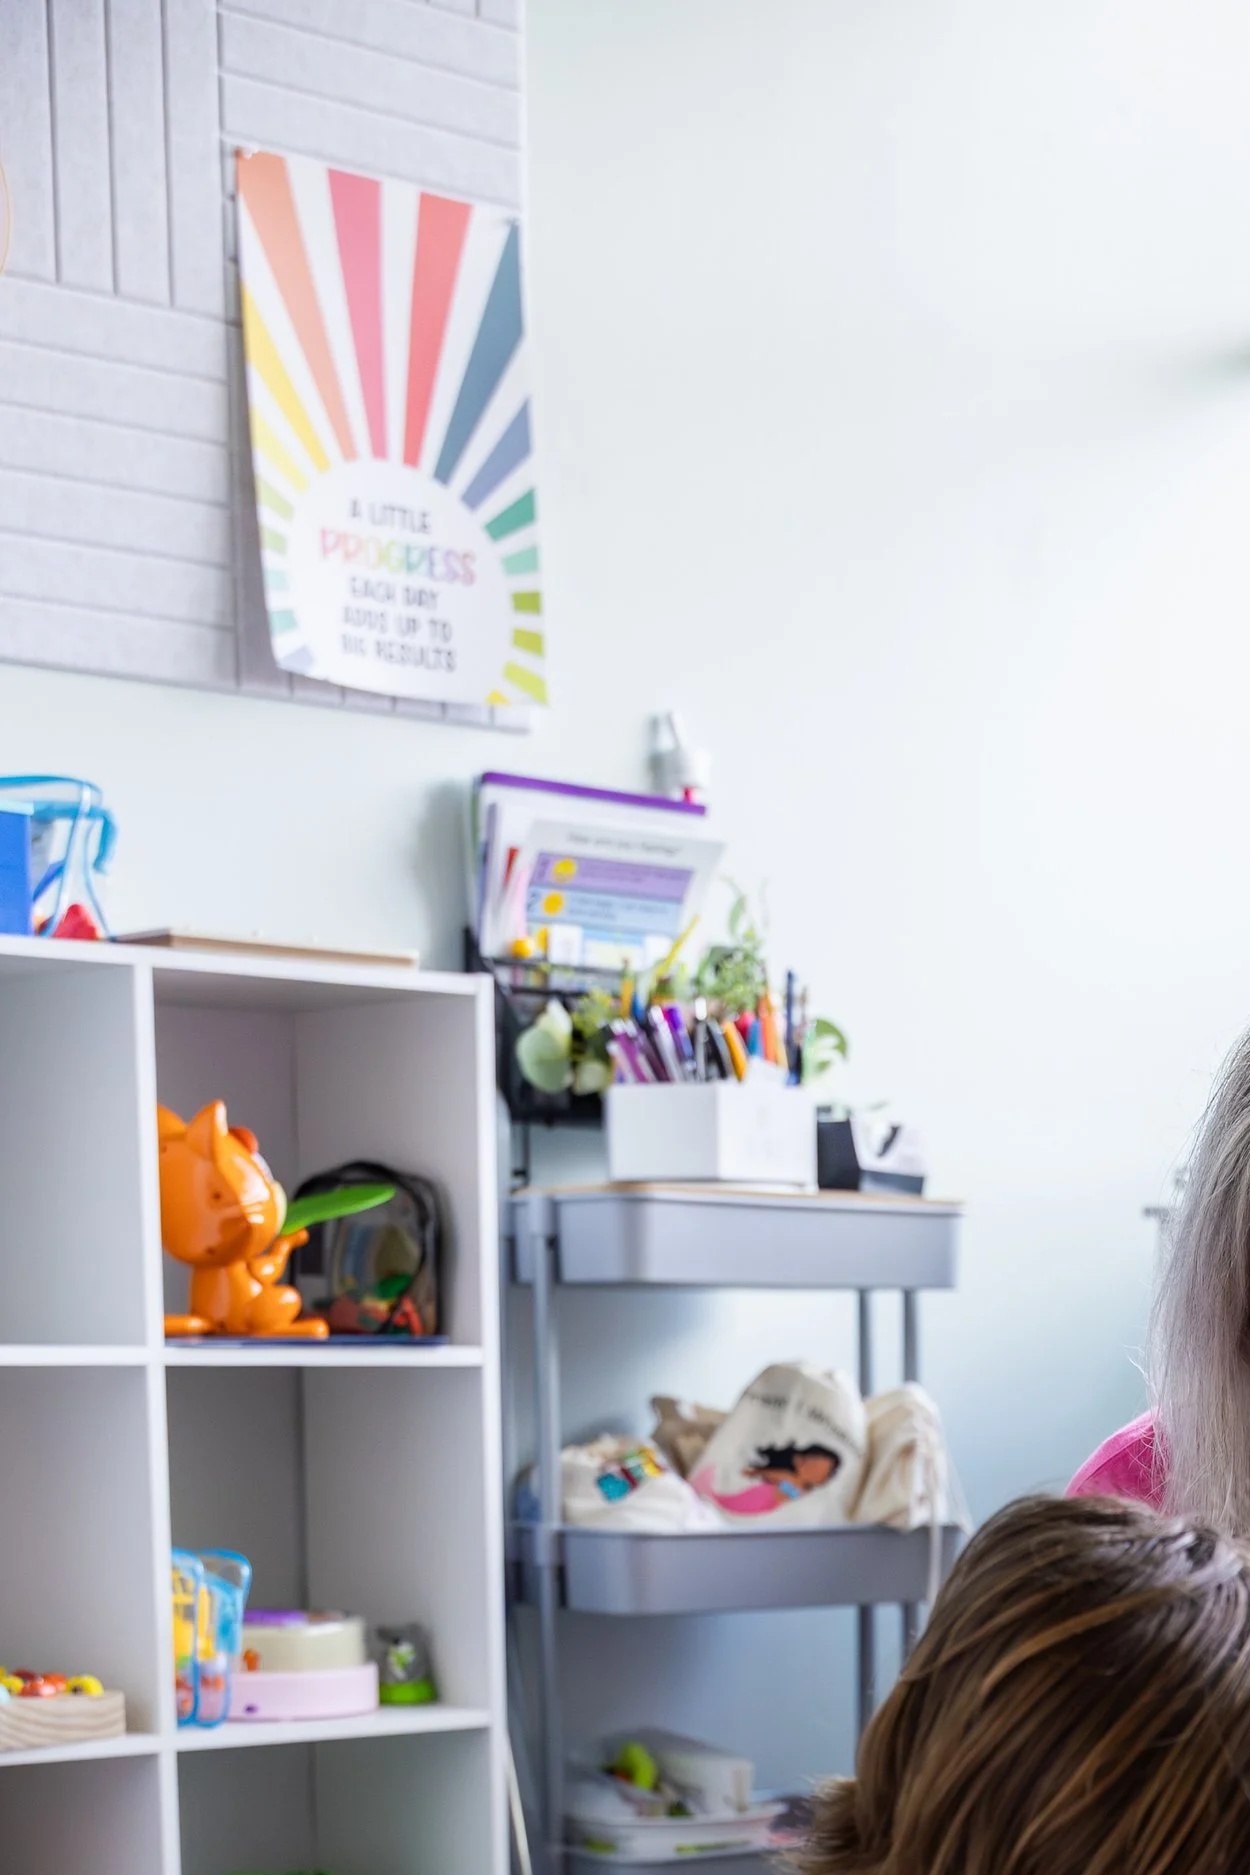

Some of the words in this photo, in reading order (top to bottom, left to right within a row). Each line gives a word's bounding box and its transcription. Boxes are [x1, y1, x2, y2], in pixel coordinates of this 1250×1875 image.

[351, 498, 361, 519] A
[368, 503, 432, 535] LITTLE
[320, 527, 477, 586] PROGRESS
[351, 576, 396, 605] EACH
[403, 586, 439, 610] DAY
[343, 605, 388, 634] ADDS
[396, 613, 422, 638] UP
[428, 617, 453, 643] TO
[375, 639, 457, 673] RESULTS
